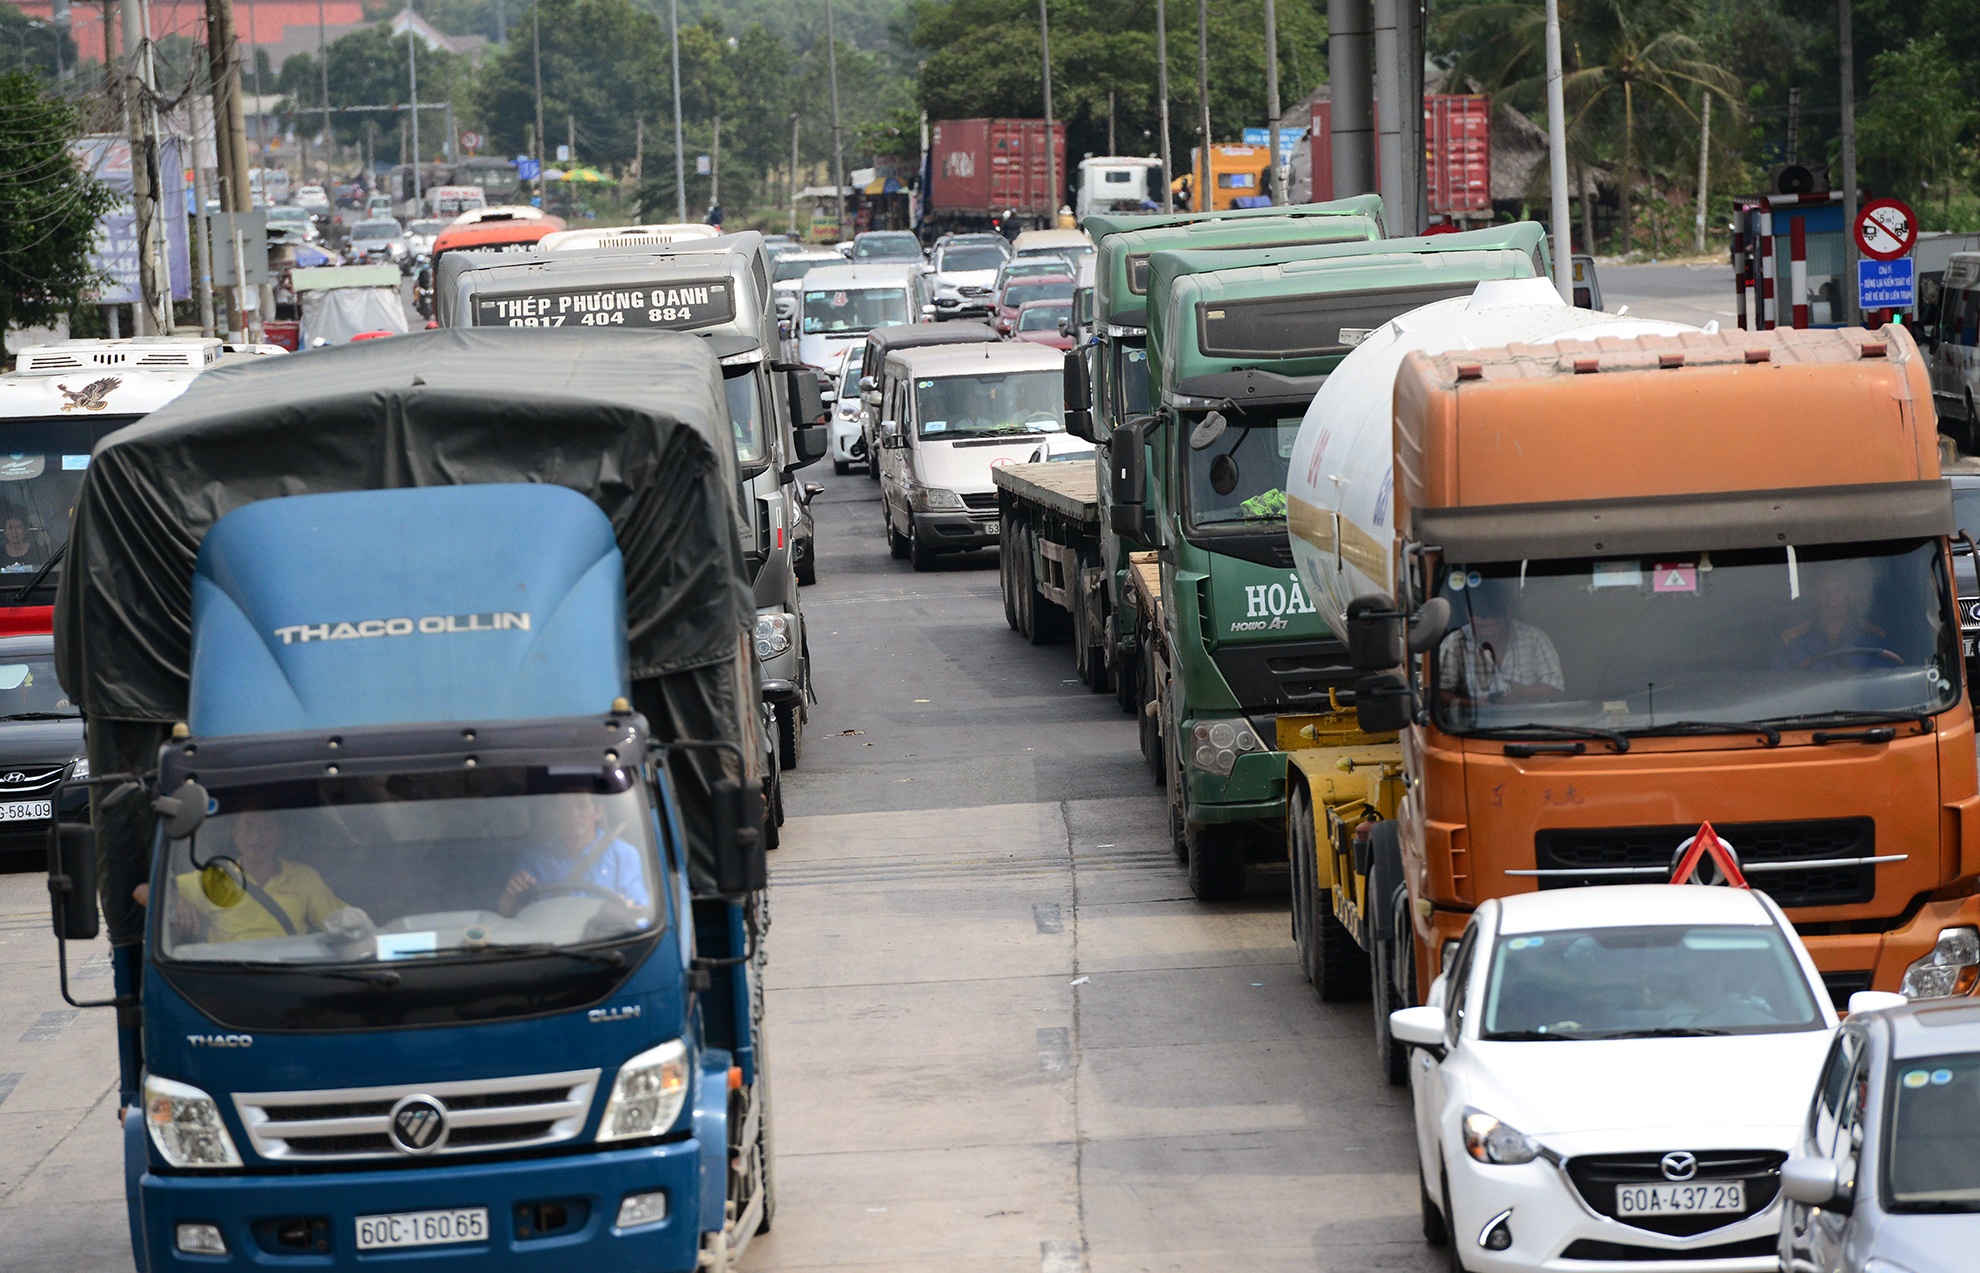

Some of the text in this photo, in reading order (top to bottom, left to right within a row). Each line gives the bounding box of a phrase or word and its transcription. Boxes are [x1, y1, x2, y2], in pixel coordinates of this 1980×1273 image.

[497, 287, 709, 318] THÉP PHƯƠNG OANH
[509, 307, 692, 327] 0917 404 884
[273, 612, 531, 645] THACO OLLIN
[1230, 616, 1289, 632] HOWO A7
[587, 1004, 641, 1023] OLLIN
[186, 1034, 254, 1048] THACO
[1622, 1186, 1740, 1212] 60A-437.29
